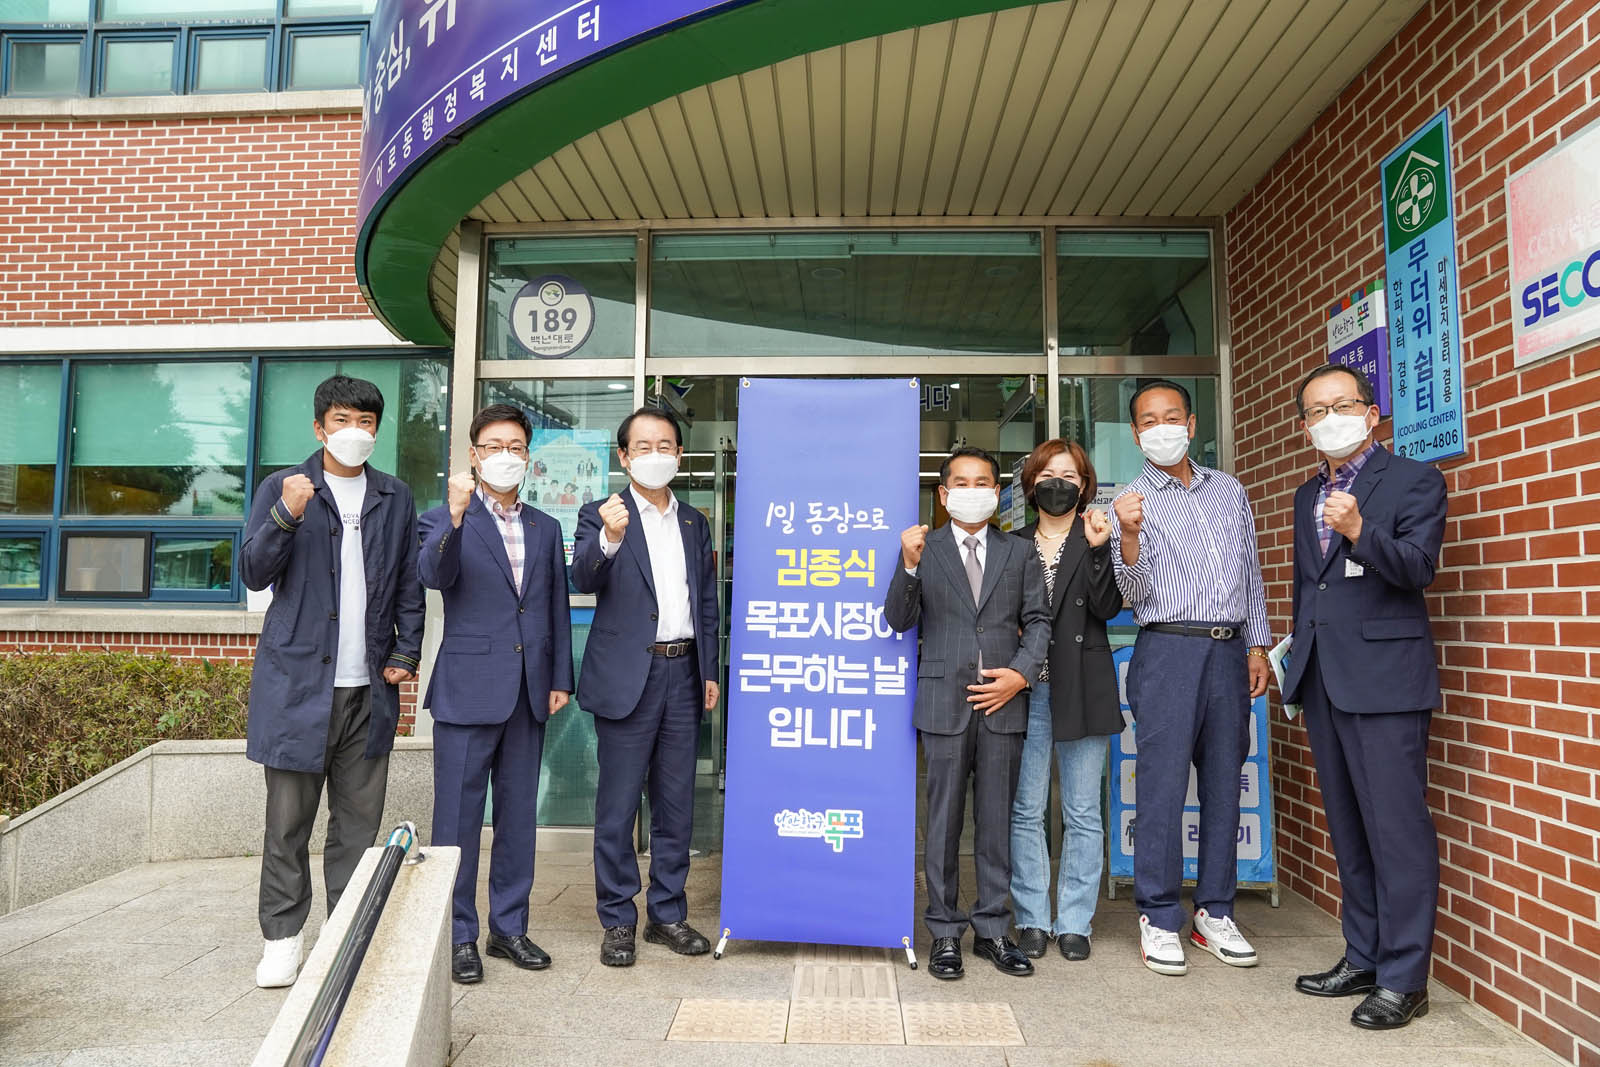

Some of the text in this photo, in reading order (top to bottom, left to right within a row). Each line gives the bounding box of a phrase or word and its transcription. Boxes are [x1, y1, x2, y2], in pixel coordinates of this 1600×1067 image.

[1392, 280, 1404, 312] 한파
[1437, 256, 1449, 326] 미세먼지
[528, 307, 577, 333] 189
[1394, 314, 1405, 349] 쉼터
[1408, 237, 1434, 413] 무더위 쉼터
[1340, 345, 1364, 368] 이로동
[1441, 330, 1451, 364] 쉼터
[1397, 408, 1457, 439] (COOLING CENTER)
[1408, 428, 1459, 457] 270-4806
[765, 502, 890, 536] 1일 동장으로
[776, 548, 876, 587] 김종식
[739, 653, 909, 695] 근무하는 날
[768, 706, 877, 750] 입니다
[825, 811, 862, 850] 목포
